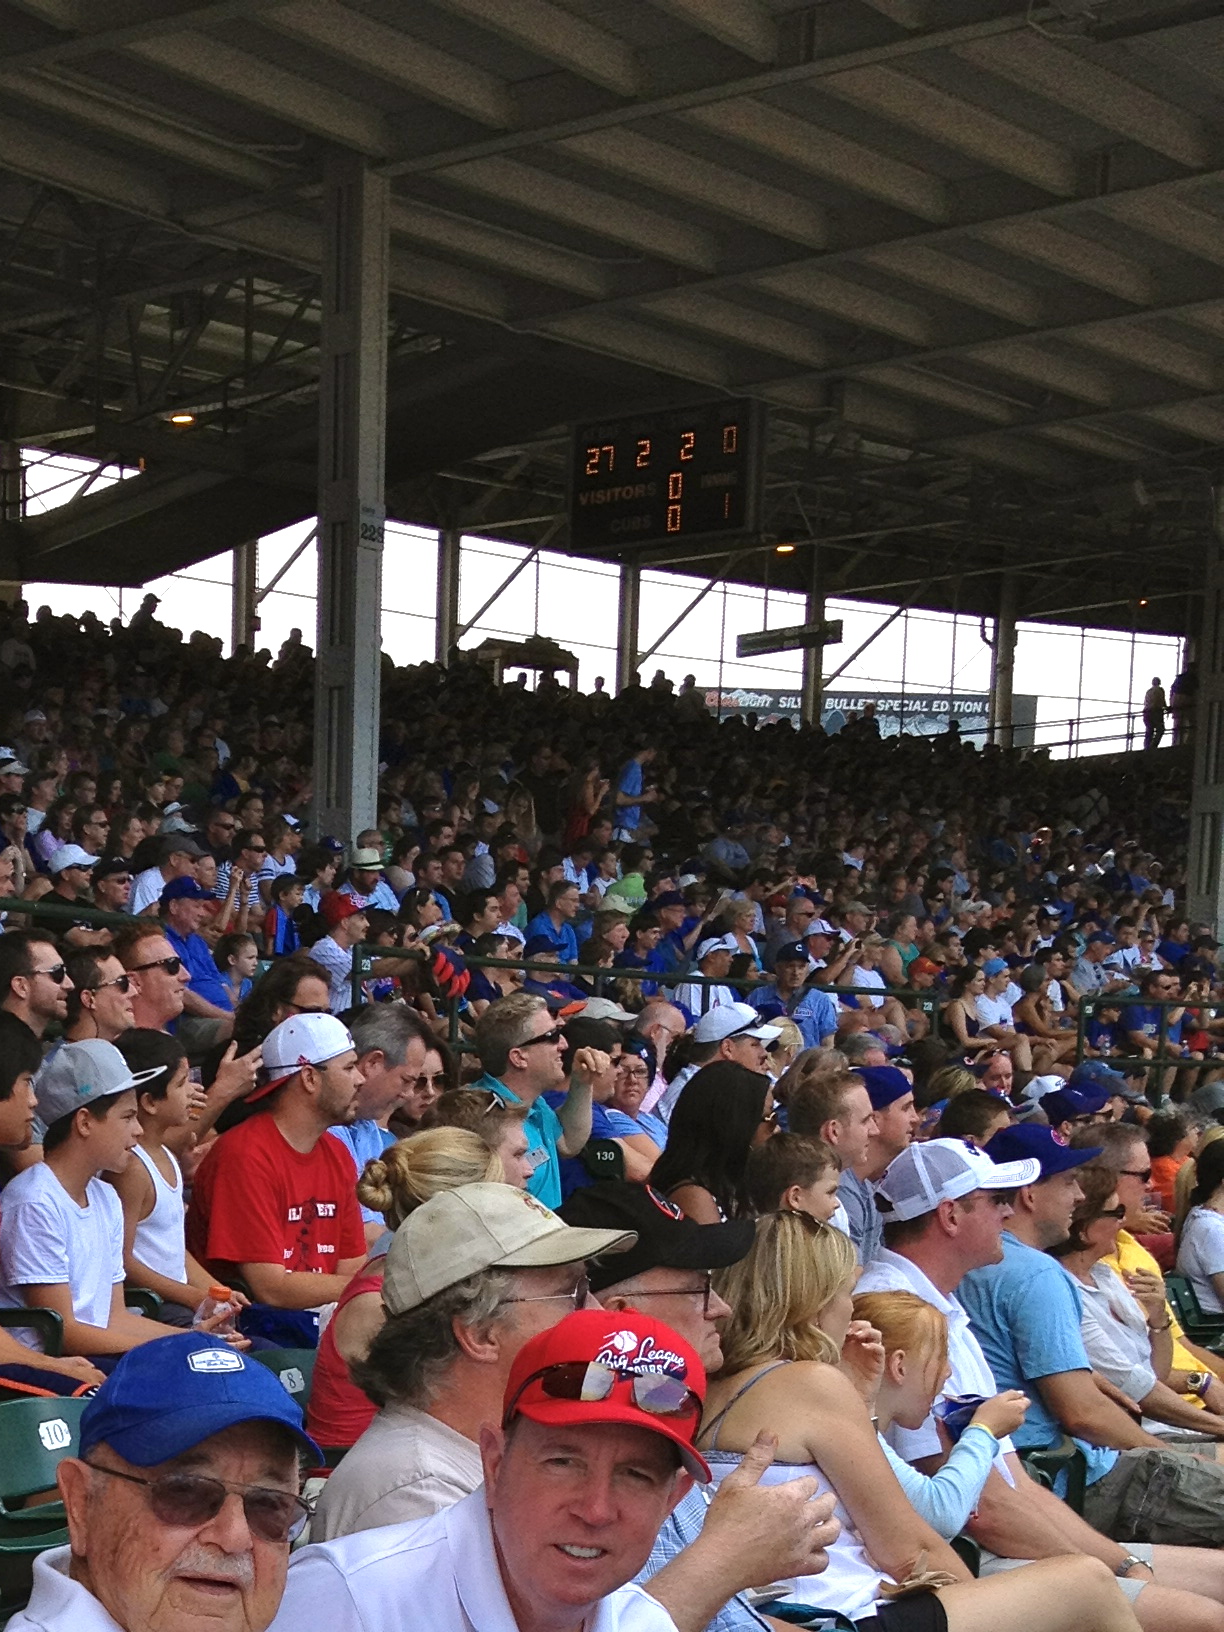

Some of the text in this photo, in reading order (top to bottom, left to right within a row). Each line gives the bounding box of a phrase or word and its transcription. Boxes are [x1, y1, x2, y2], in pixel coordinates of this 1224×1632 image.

[584, 425, 738, 476] 27 2 2 0
[579, 482, 657, 505] VISITORS
[667, 471, 684, 500] 0
[666, 504, 682, 533] 0
[932, 700, 983, 713] EDTION
[596, 1151, 615, 1161] 130
[632, 1336, 685, 1372] League
[286, 1372, 297, 1389] 8
[45, 1423, 64, 1445] 10
